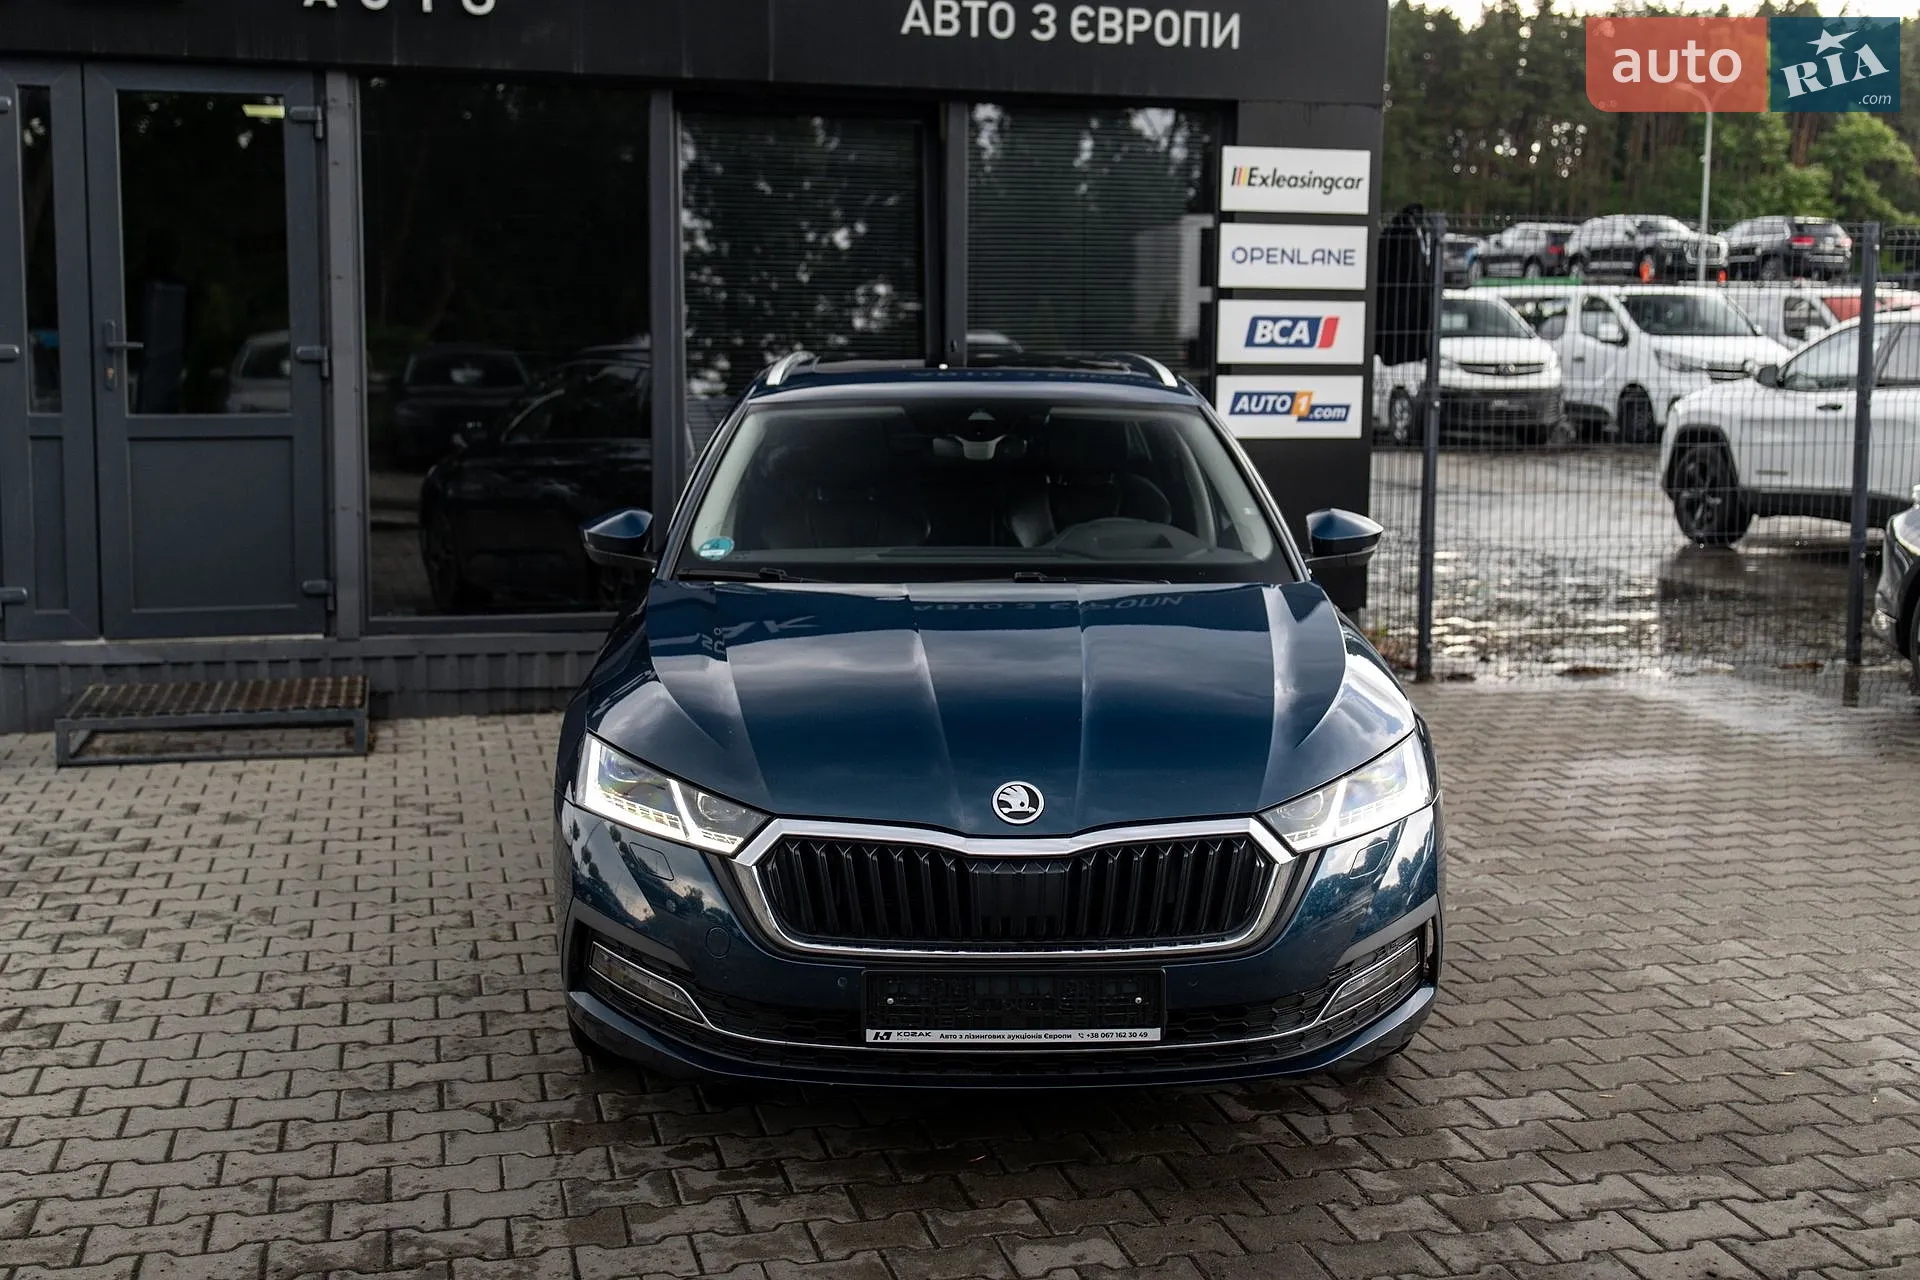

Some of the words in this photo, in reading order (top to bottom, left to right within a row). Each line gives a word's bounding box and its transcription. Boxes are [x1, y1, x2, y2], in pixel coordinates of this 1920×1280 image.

[901, 0, 1016, 39] АВТО
[1030, 4, 1058, 41] З
[1070, 5, 1241, 49] ЄВРОПИ
[1231, 246, 1356, 267] OPENLANE
[1253, 319, 1310, 345] BCA
